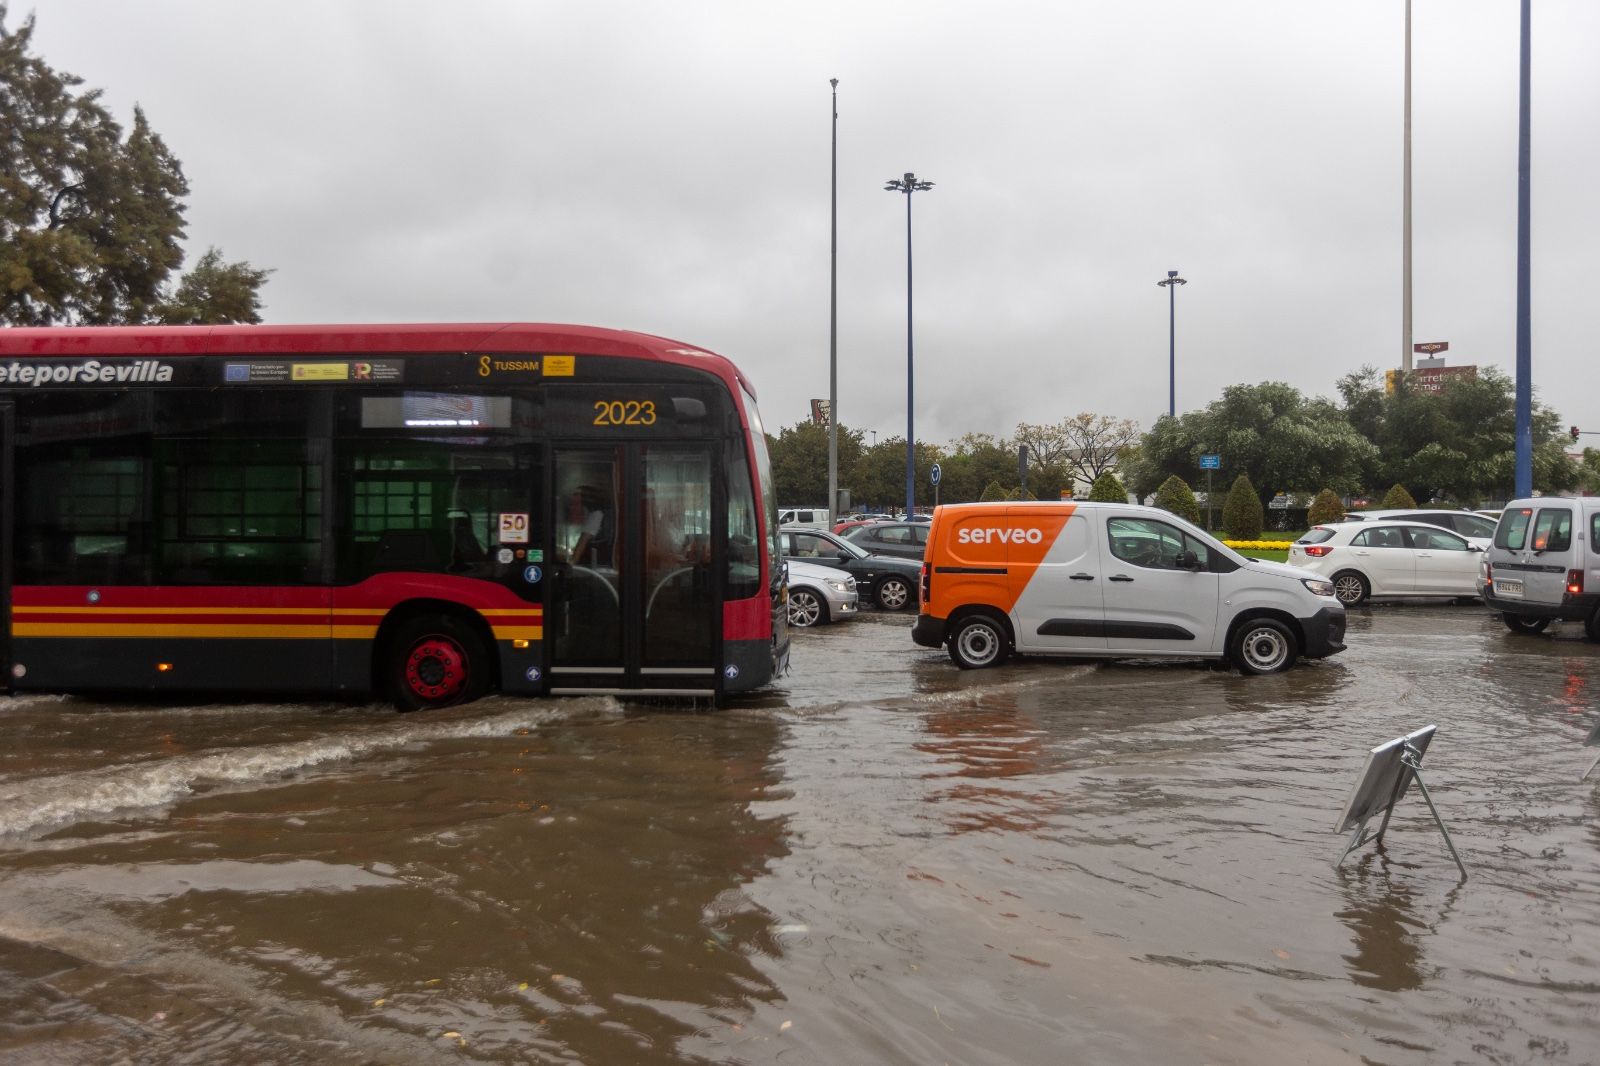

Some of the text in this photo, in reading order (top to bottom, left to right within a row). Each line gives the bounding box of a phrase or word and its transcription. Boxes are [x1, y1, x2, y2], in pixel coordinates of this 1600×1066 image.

[495, 361, 539, 371] TUSSAM
[593, 400, 657, 426] 2023
[502, 515, 526, 531] 50
[958, 528, 1043, 544] serveo
